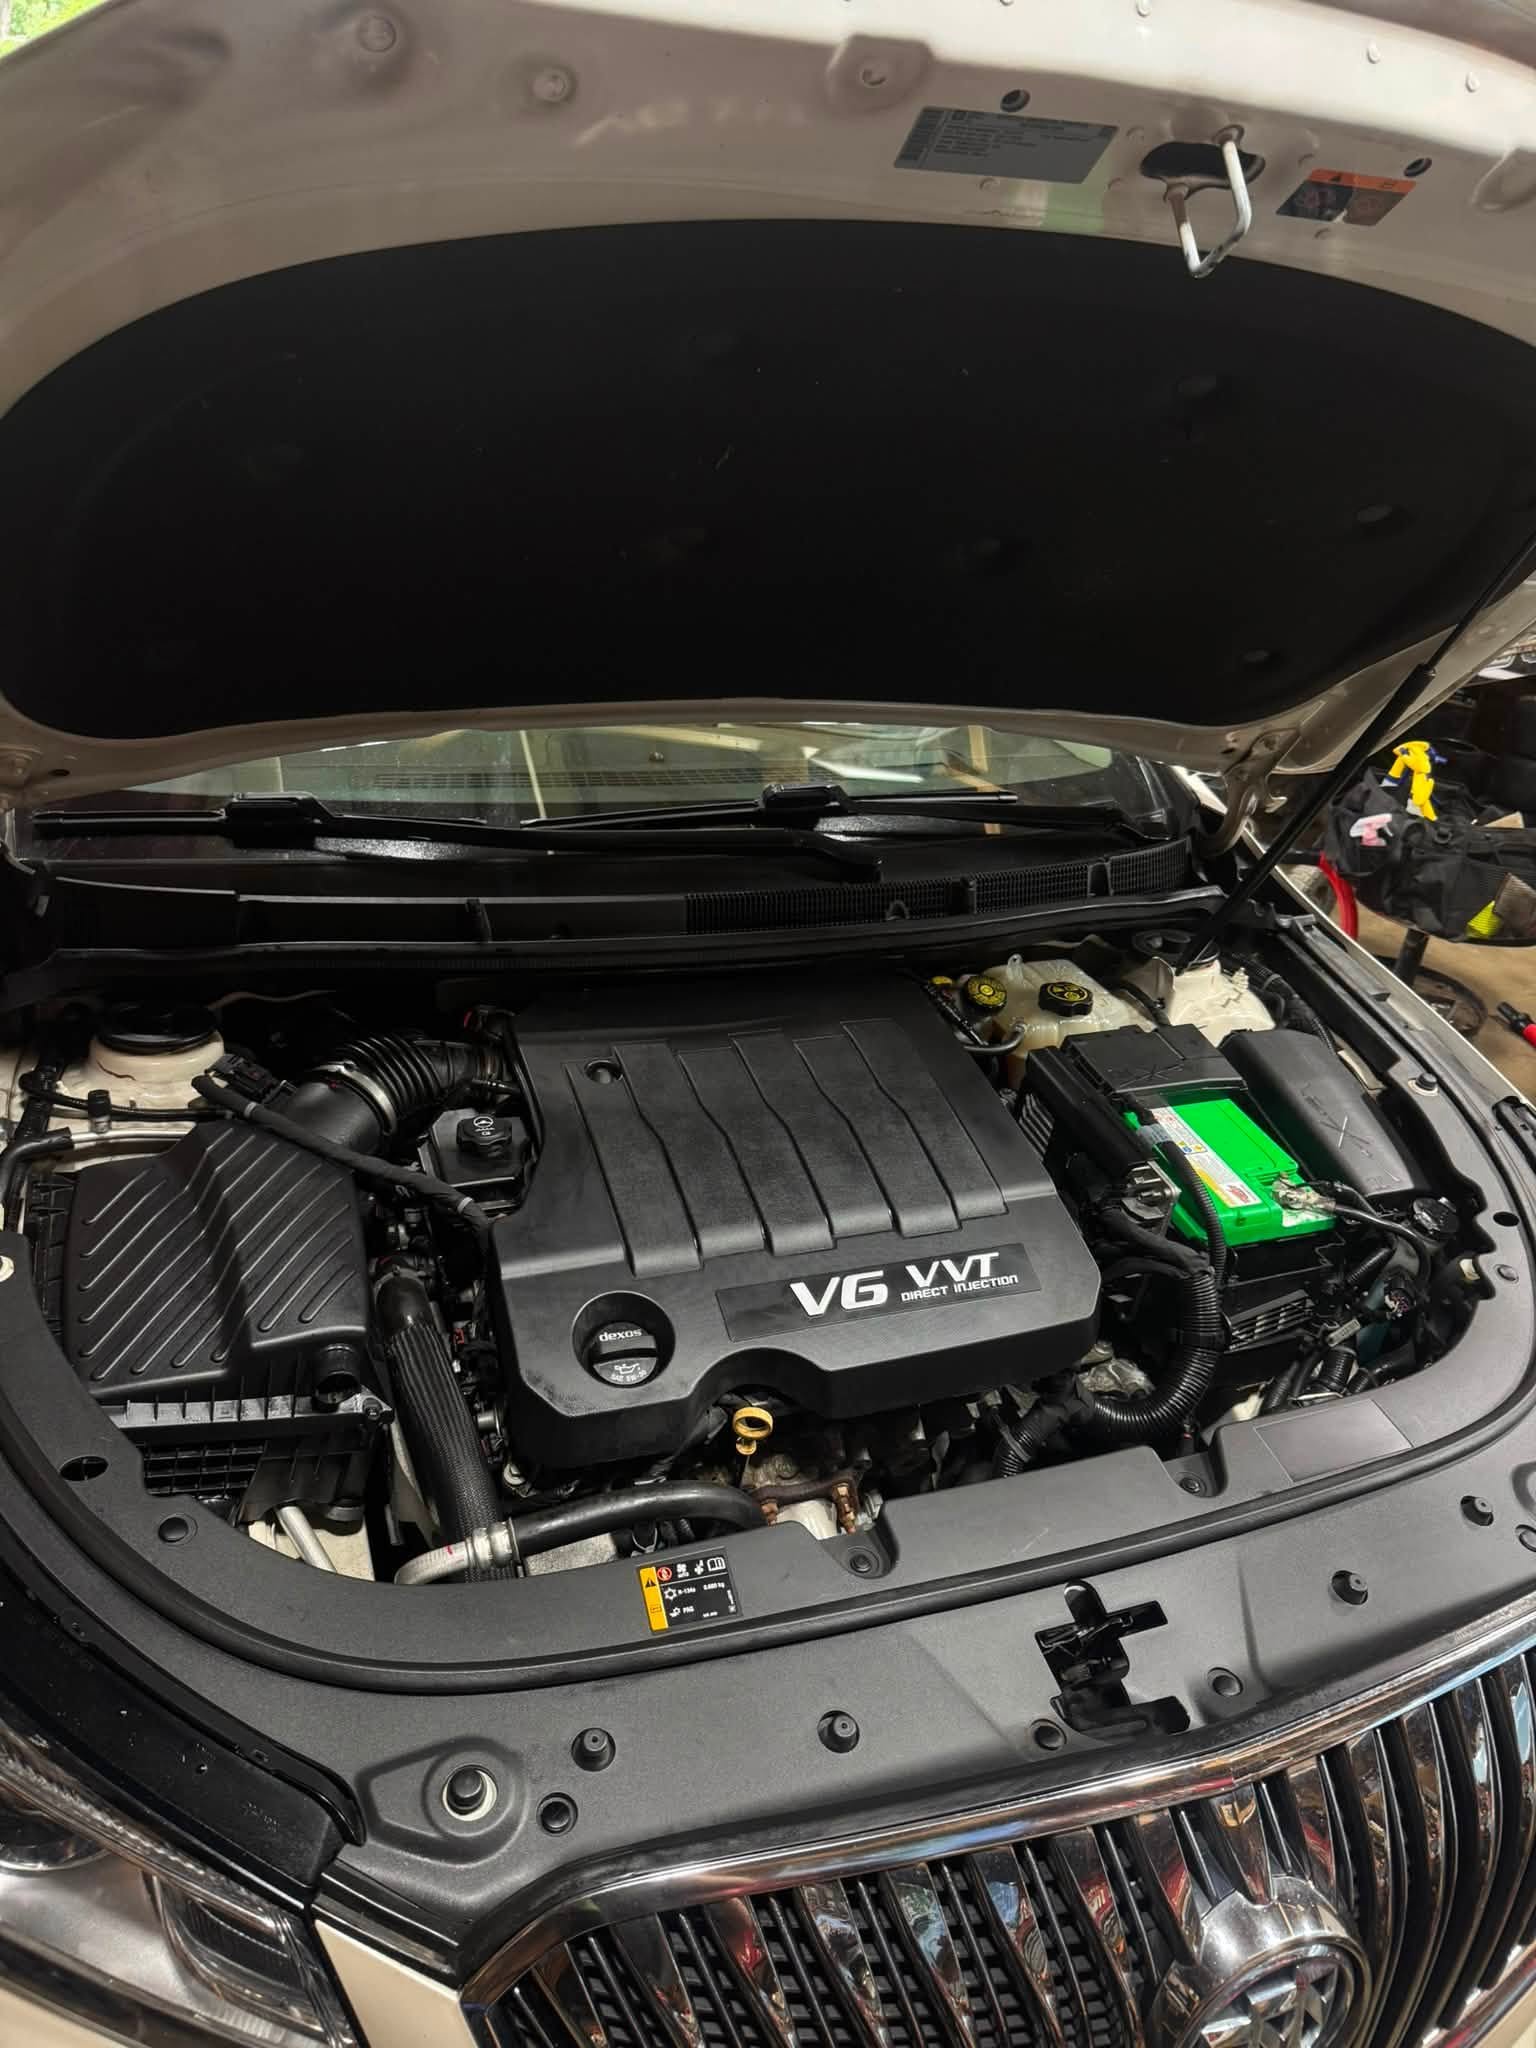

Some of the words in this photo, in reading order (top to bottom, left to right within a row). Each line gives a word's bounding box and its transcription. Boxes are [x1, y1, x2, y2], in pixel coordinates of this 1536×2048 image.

[905, 1252, 1000, 1288] VVT
[789, 1270, 889, 1317] V6
[901, 1286, 949, 1302] DIRECT
[954, 1274, 1019, 1293] INJECTION
[599, 1328, 642, 1342] dexos
